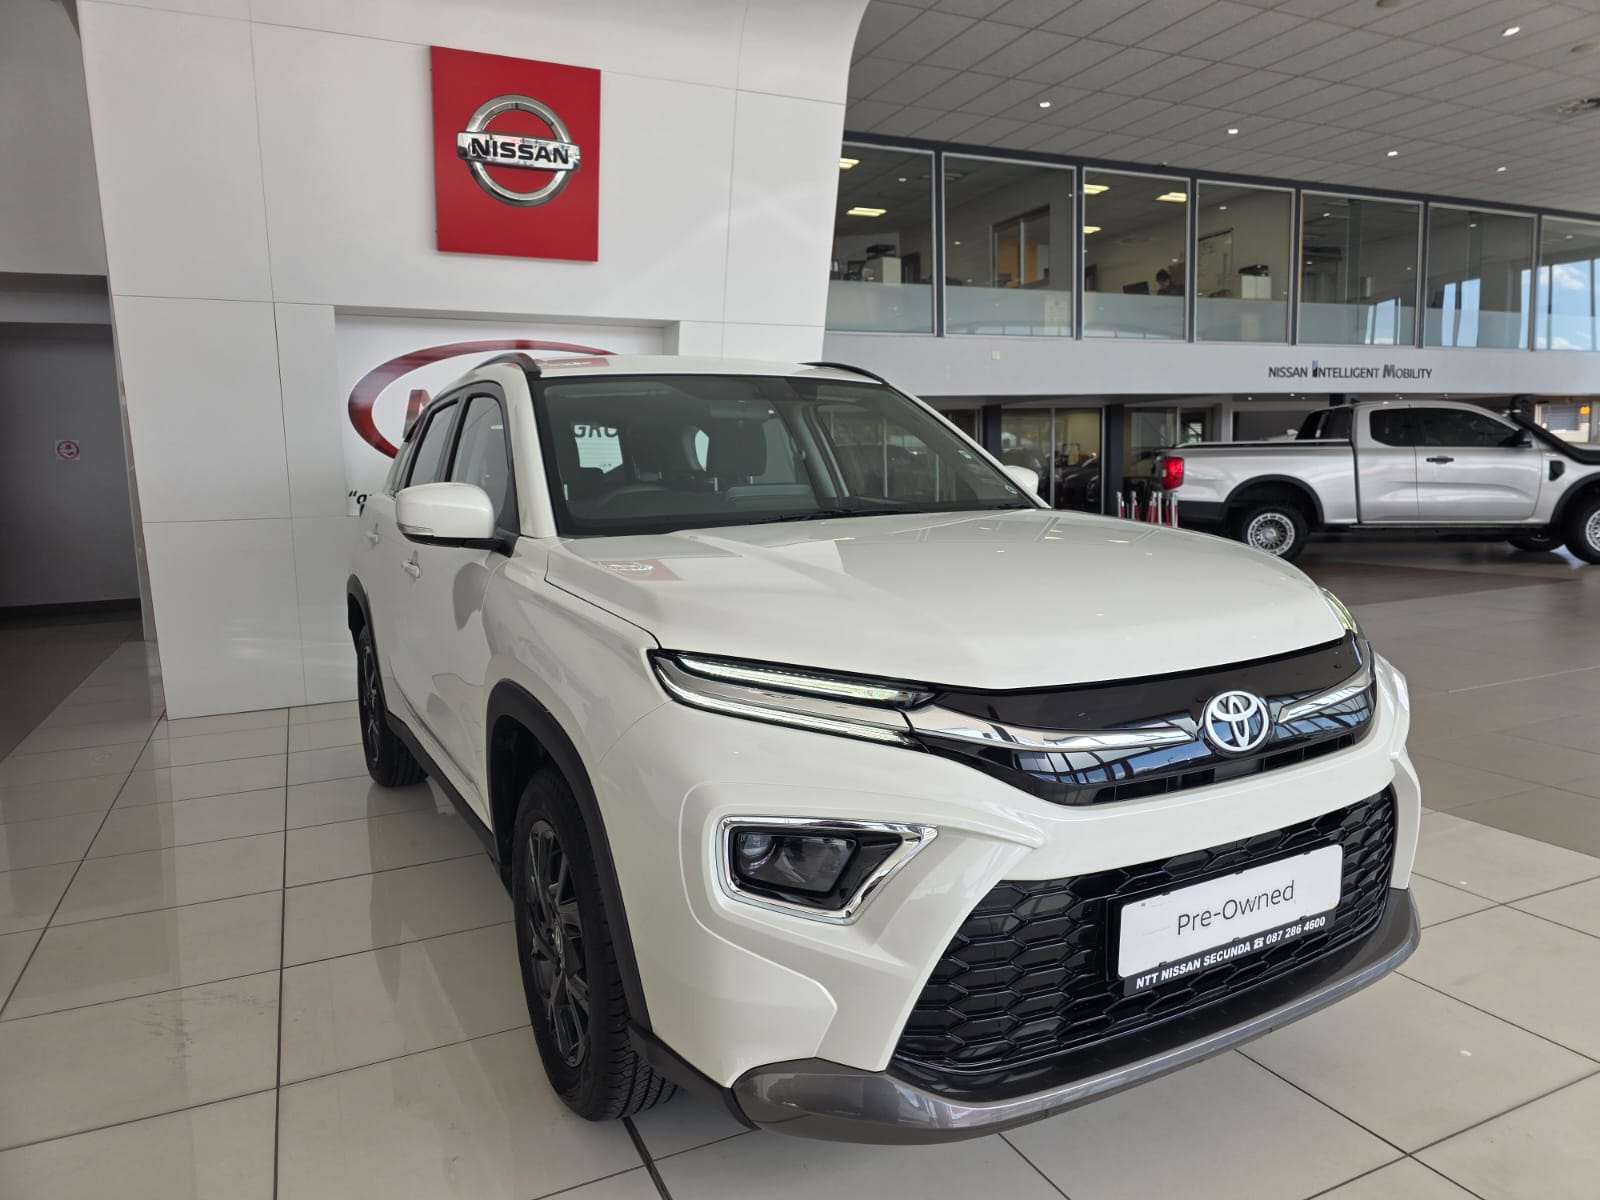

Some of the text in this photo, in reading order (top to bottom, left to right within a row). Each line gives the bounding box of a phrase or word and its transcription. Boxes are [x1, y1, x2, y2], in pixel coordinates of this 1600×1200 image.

[471, 138, 569, 165] NISSAN
[1268, 360, 1432, 379] NISSAN INTELLIGENT MOBILITY
[1178, 879, 1295, 936] Pre-Owned
[1135, 916, 1326, 990] NTT NISSAN SECUNDA 087 286 4600
